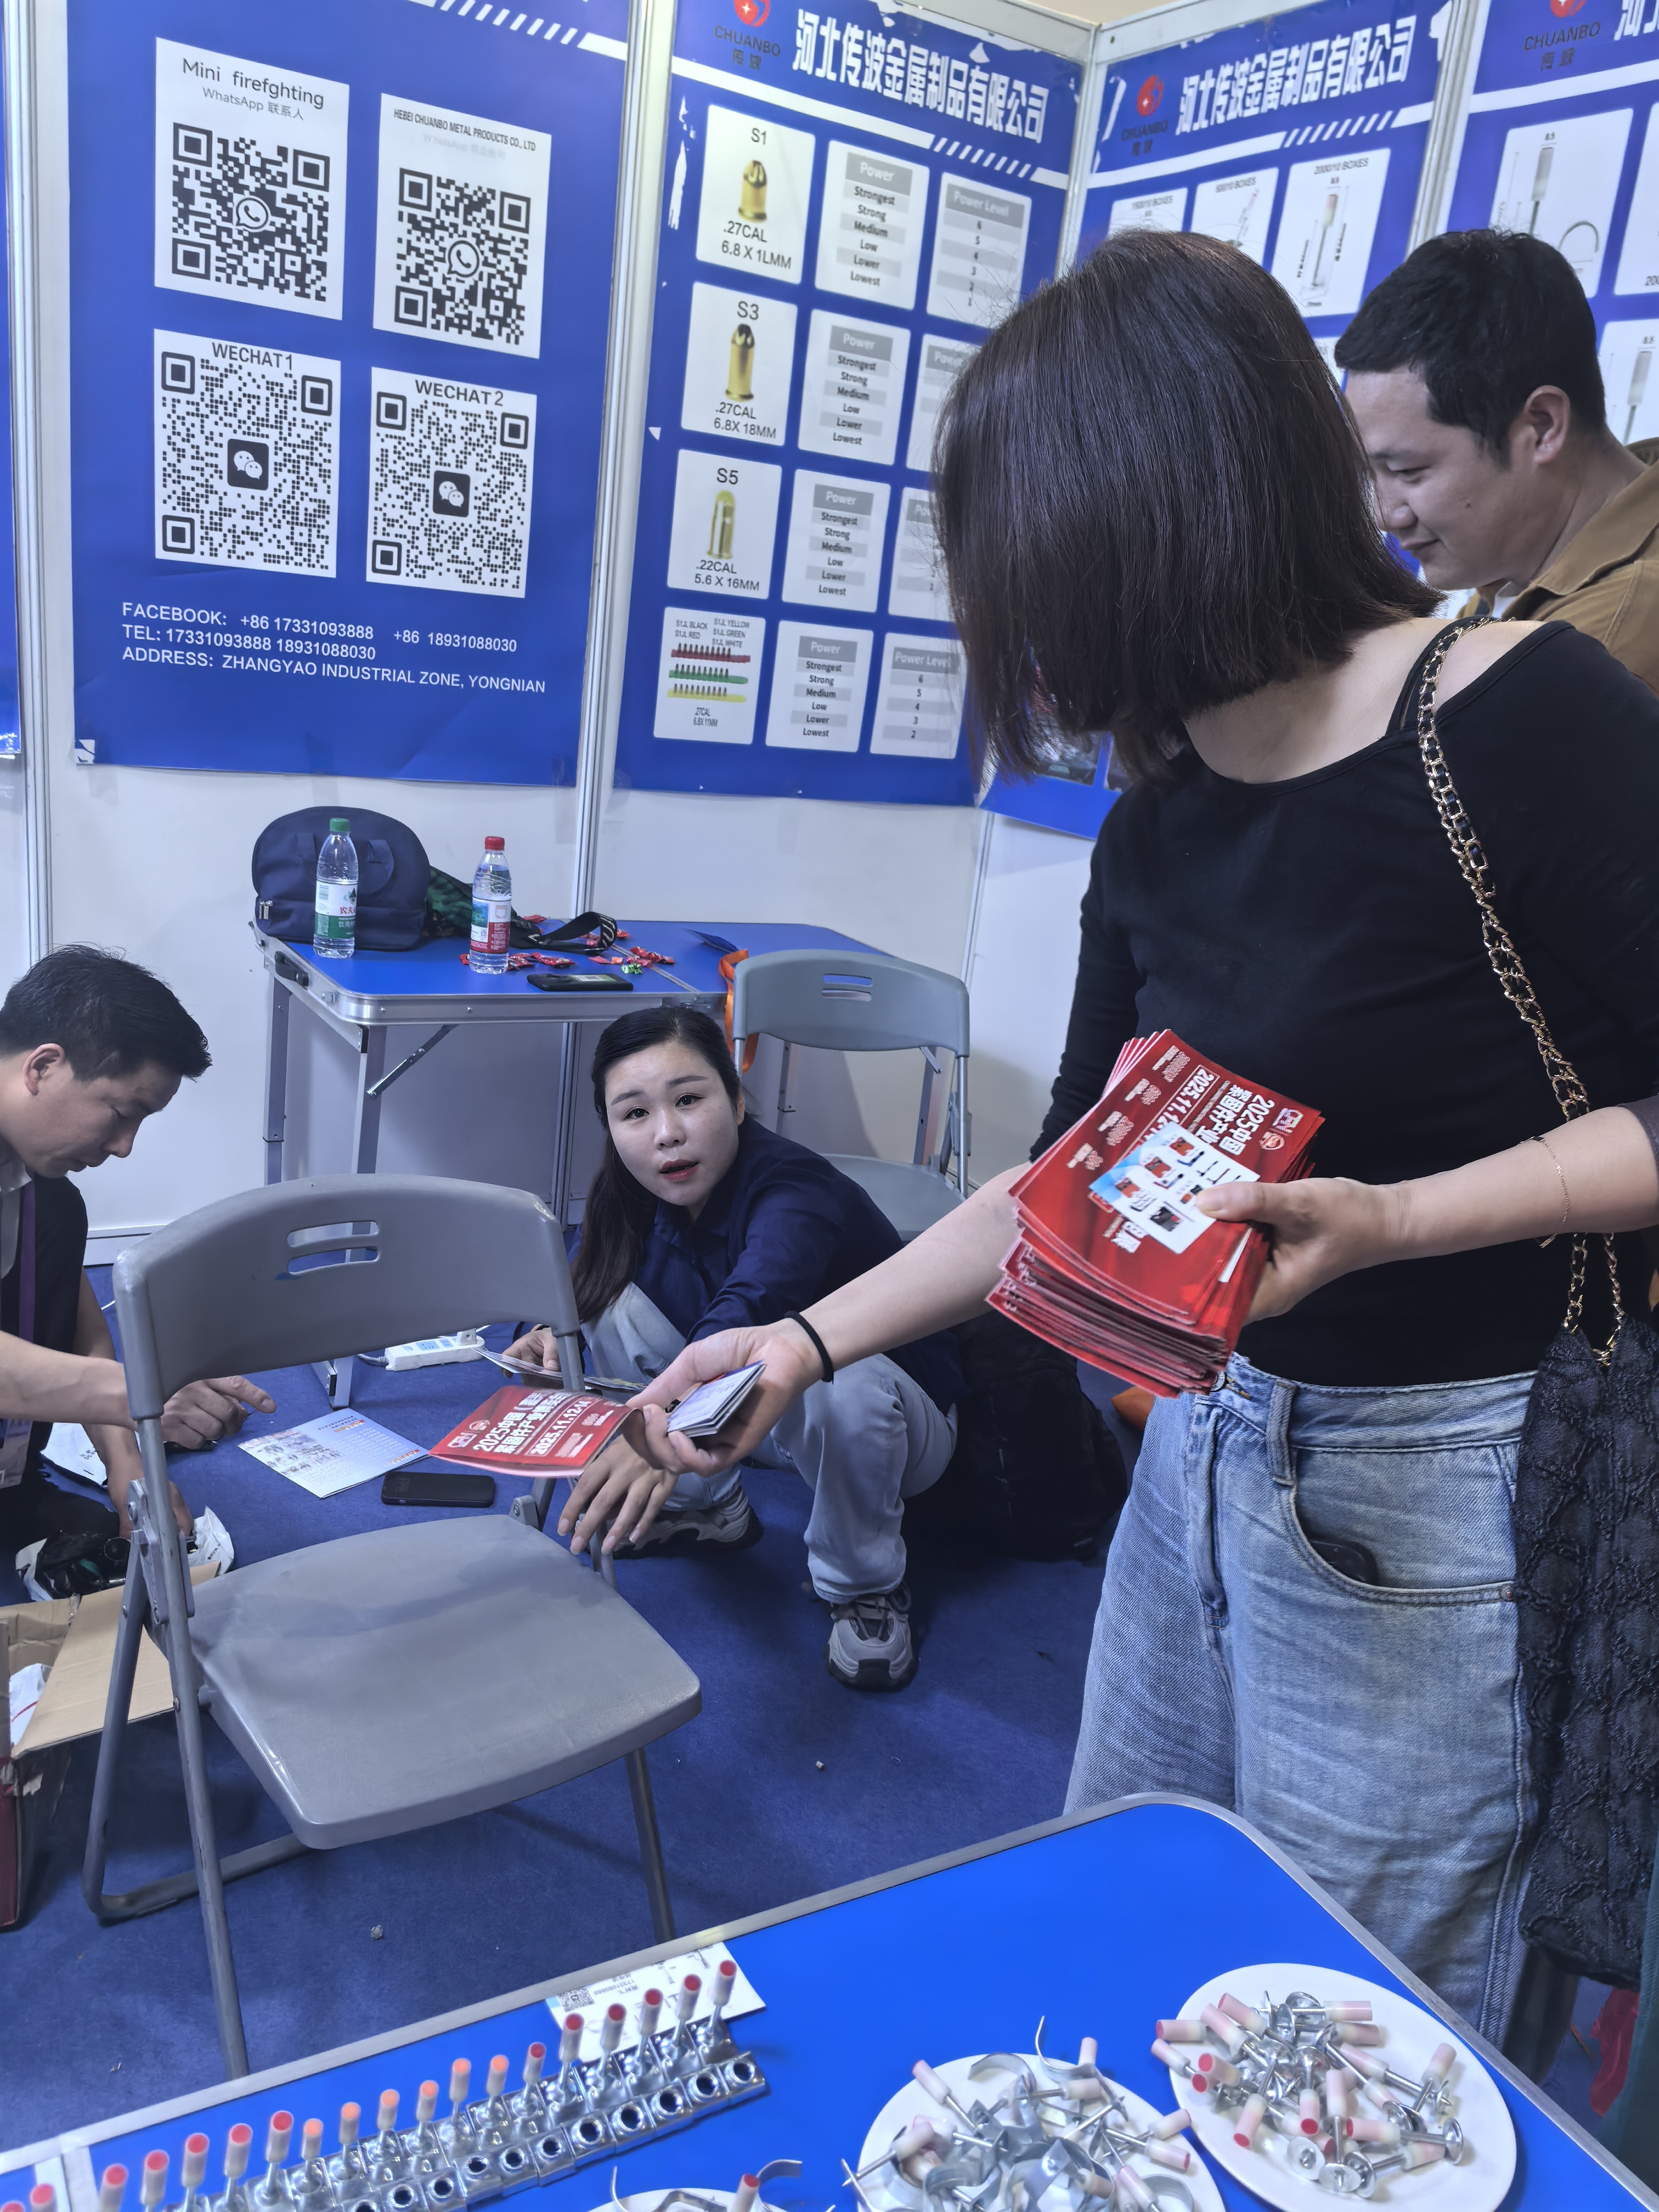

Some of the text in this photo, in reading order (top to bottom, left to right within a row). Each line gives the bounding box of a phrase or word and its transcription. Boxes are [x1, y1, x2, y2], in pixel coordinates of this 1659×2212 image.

[714, 25, 780, 57] CHUANBO
[1524, 21, 1601, 51] CHUANBO
[183, 57, 324, 110] Mini firefghting
[792, 9, 1049, 144] 河北传波金属制品有限公司
[203, 87, 304, 121] WhatsApp 联系人
[394, 108, 413, 122] HEBEI
[415, 113, 448, 130] CHUANBO
[449, 122, 471, 136] METAL
[474, 127, 508, 145] PRODUCTS
[523, 139, 536, 151] LTD
[751, 127, 767, 145] S1
[1121, 119, 1168, 141] CHUANBO
[859, 161, 895, 181] Power
[854, 185, 895, 205] Strongest
[954, 191, 1009, 217] Power Level
[857, 204, 887, 223] Strong
[724, 220, 767, 242] .27CAL
[854, 220, 888, 238] Medium
[721, 240, 740, 257] 6.8
[744, 245, 753, 260] X
[860, 239, 878, 252] Low
[853, 255, 880, 269] Lower
[851, 271, 881, 286] Lowest
[737, 301, 759, 320] S3
[843, 333, 876, 350] Power
[837, 355, 876, 372] Strongest
[840, 371, 868, 387] Strong
[837, 386, 869, 401] Medium
[716, 401, 757, 420] .27CAL
[842, 403, 860, 414] Low
[743, 423, 777, 439] 18MM
[836, 417, 862, 430] Lower
[833, 432, 862, 446] Lowest
[716, 468, 739, 485] S5
[826, 491, 857, 505] Power
[821, 511, 858, 526] Strongest
[825, 527, 850, 541] Strong
[821, 541, 852, 554] Medium
[696, 559, 737, 574] .22CAL
[827, 557, 844, 567] Low
[694, 574, 760, 591] 5.6 X 16MM
[821, 570, 847, 582] Lower
[819, 584, 847, 596] Lowest
[122, 602, 517, 652] FACEBOOK: +86 17331093888 +86 18931088030
[690, 621, 708, 630] BLACK
[727, 619, 751, 629] YELLOW
[689, 631, 700, 639] RED
[726, 629, 746, 638] GREEN
[122, 624, 376, 660] TEL: 17331093888 18931088030
[725, 639, 743, 648] WHITE
[811, 641, 841, 655] Power
[806, 660, 842, 673] Strongest
[894, 651, 951, 668] Power Level
[122, 646, 546, 693] ADDRESS: ZHANGYAO INDUSTRIAL ZONE, YONGNIAN
[809, 675, 834, 686] Strong
[919, 675, 923, 683] 6
[806, 688, 836, 698] Medium
[917, 689, 921, 697] 5
[812, 702, 827, 711] Low
[806, 714, 830, 724] Lower
[913, 716, 918, 725] 3
[803, 727, 830, 737] Lowest
[911, 730, 916, 739] 2
[1218, 1094, 1275, 1156] 2025中国
